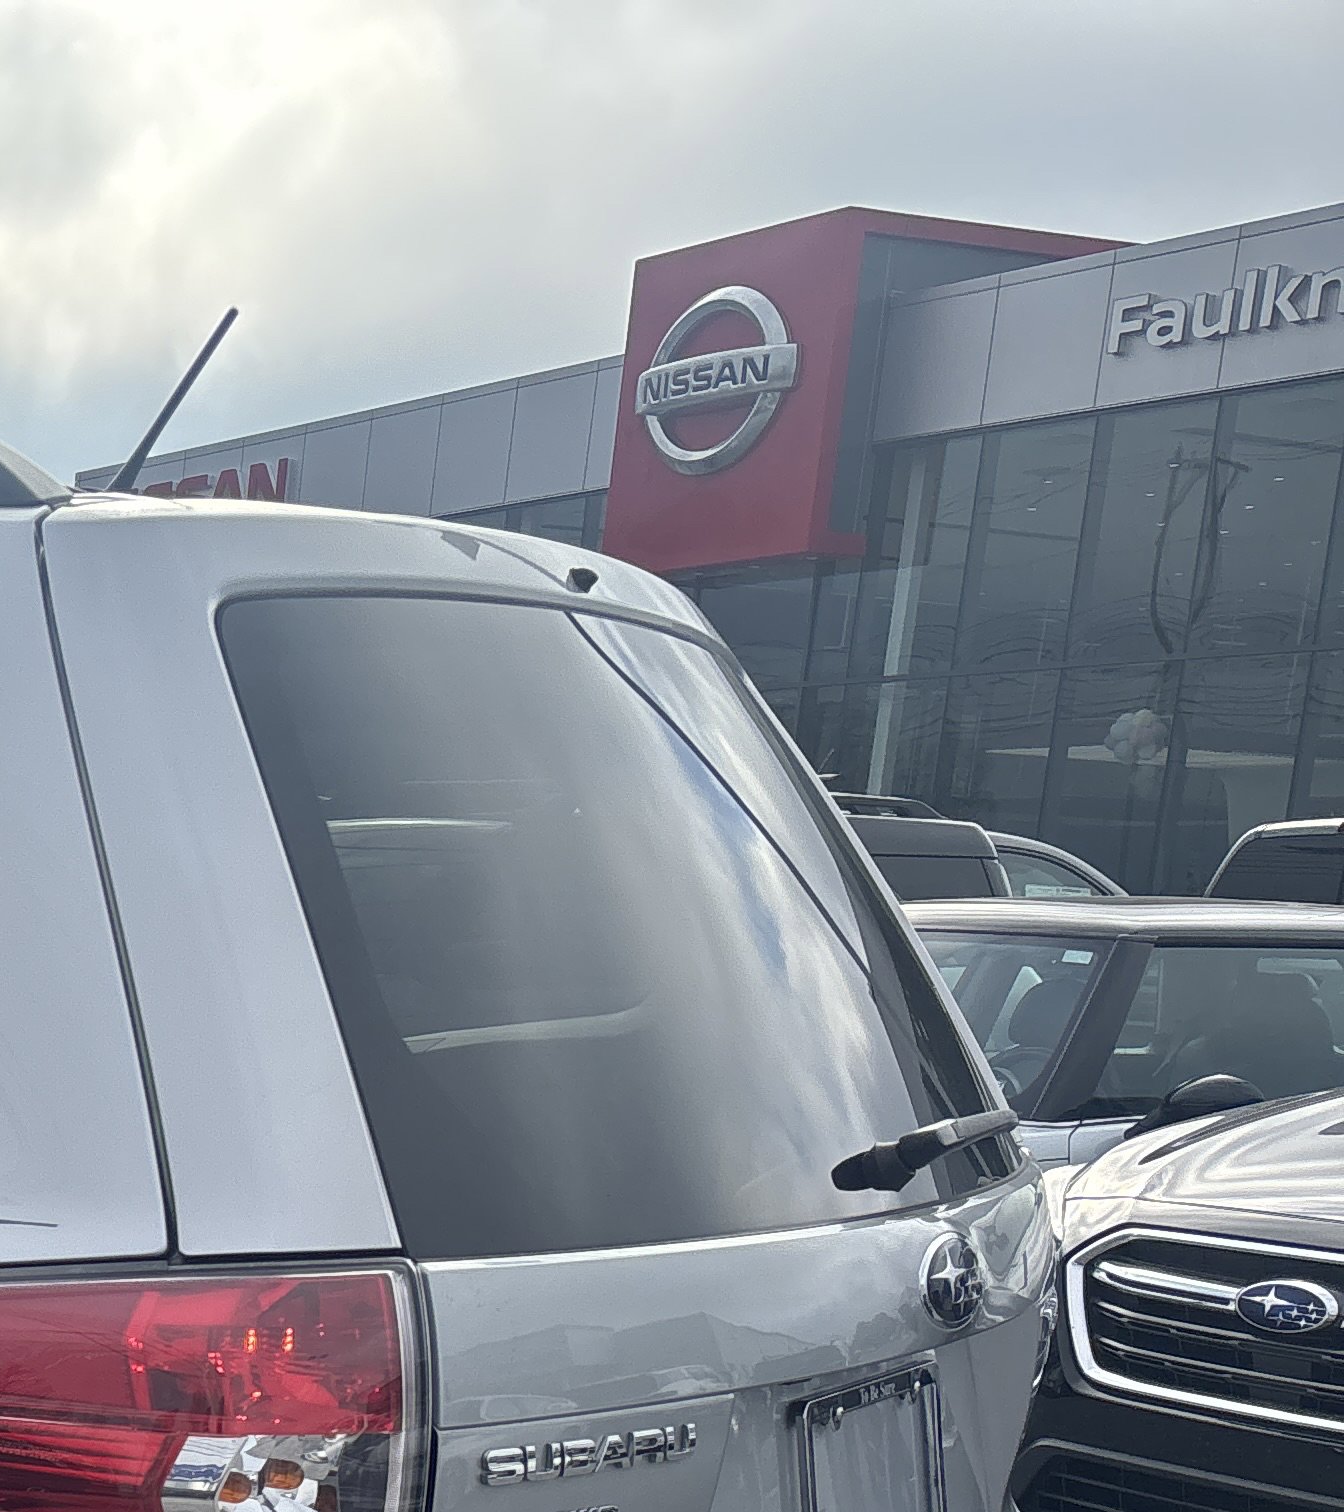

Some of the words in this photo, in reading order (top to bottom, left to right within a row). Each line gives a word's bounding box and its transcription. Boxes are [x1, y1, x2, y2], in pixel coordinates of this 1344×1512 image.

[643, 353, 770, 405] NISSAN
[858, 1387, 869, 1405] To
[869, 1385, 879, 1402] Be
[879, 1381, 896, 1398] Sure
[480, 1423, 697, 1486] SUBARU
